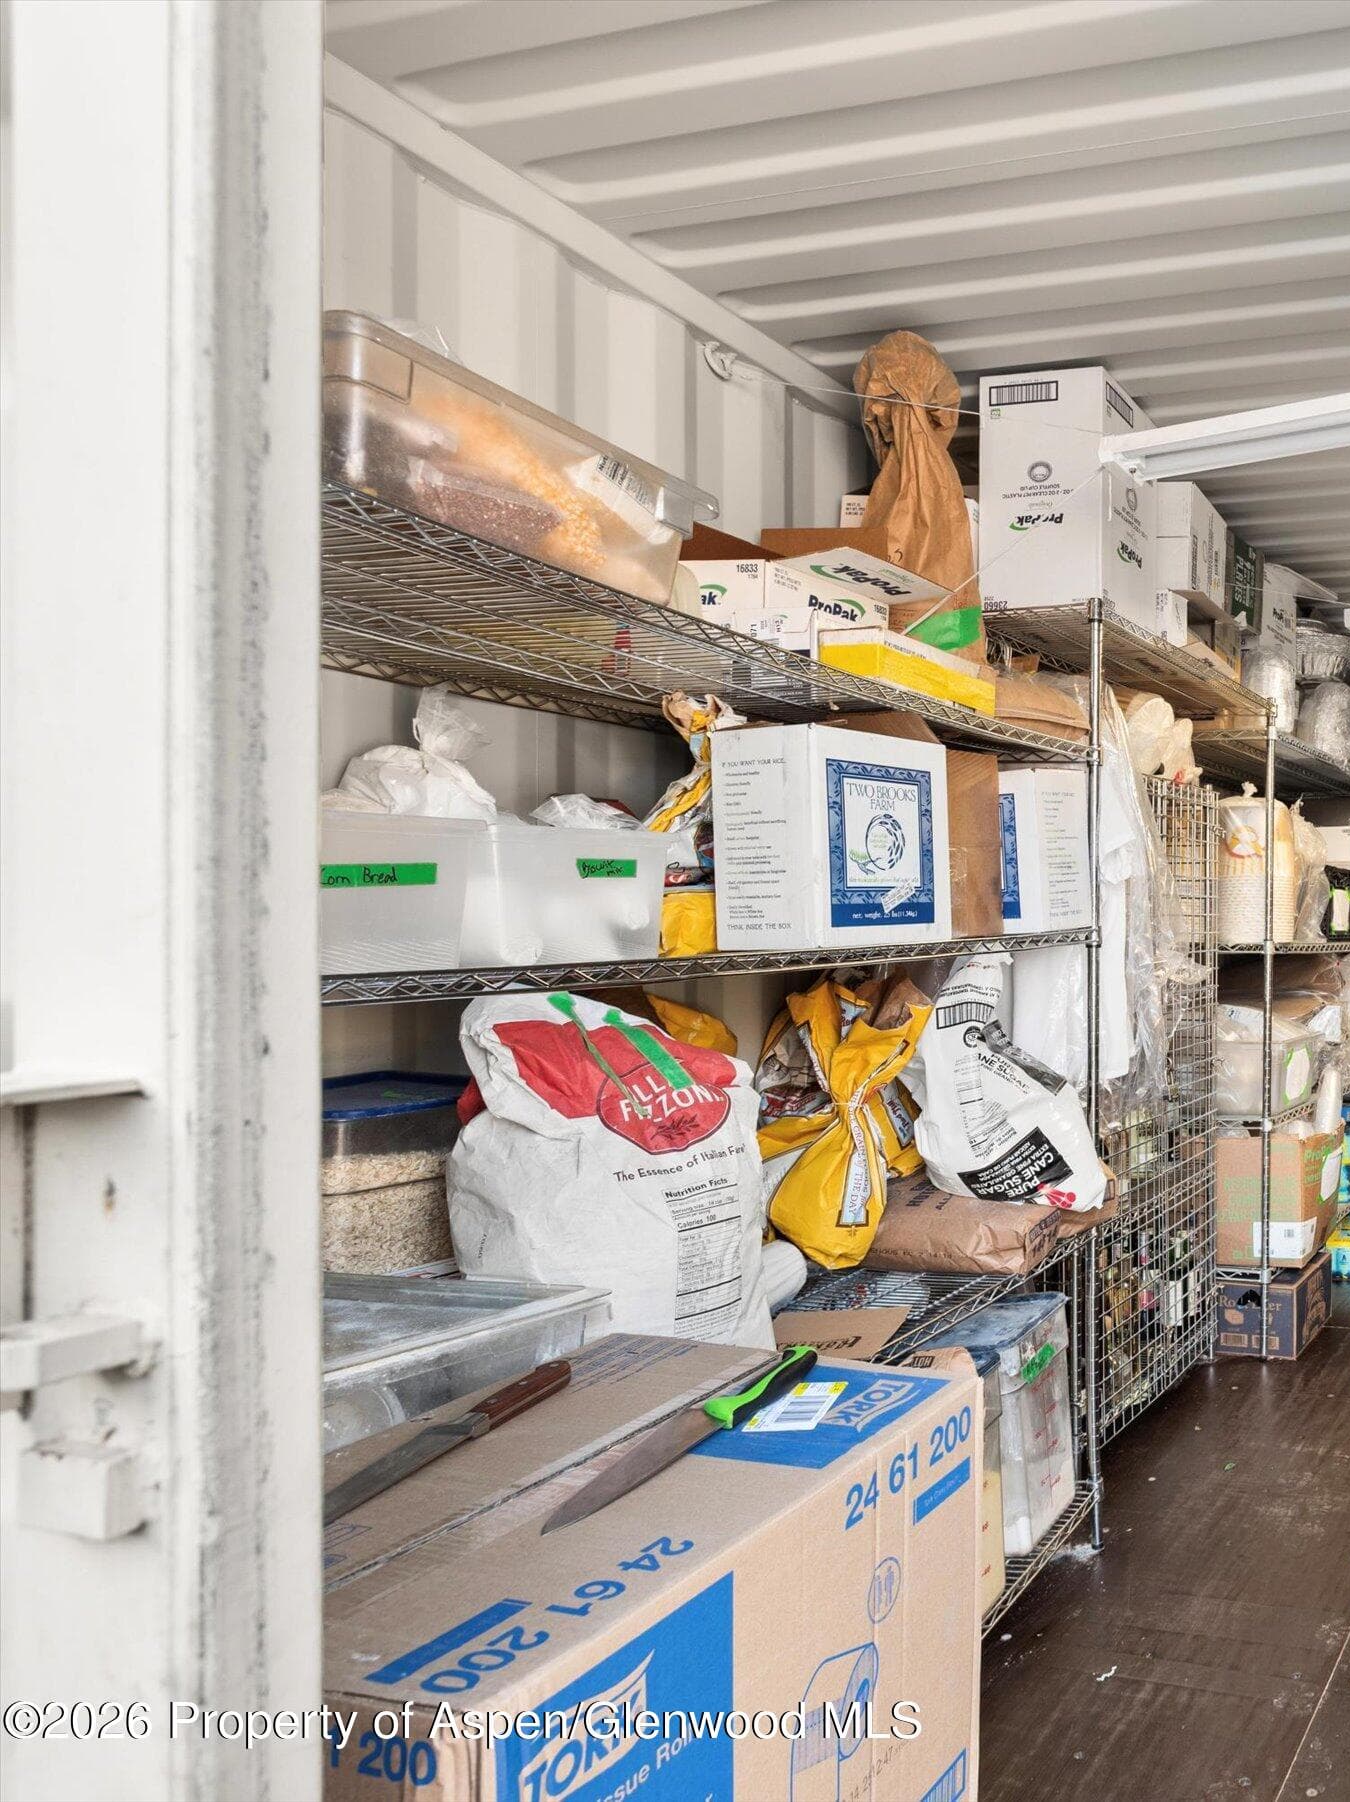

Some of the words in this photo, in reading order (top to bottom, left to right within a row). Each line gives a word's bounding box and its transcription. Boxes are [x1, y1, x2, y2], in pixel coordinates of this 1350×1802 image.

[831, 565, 912, 596] ProPak
[846, 782, 875, 799] TWO
[876, 785, 917, 802] BROOKS
[870, 798, 895, 811] FARM
[362, 865, 398, 884] Bread
[1031, 1143, 1050, 1160] EXTRA
[613, 1169, 635, 1183] The
[637, 1165, 683, 1179] Essence
[686, 1154, 700, 1169] of
[700, 1149, 728, 1162] Italian
[1015, 1158, 1032, 1173] FINE
[1021, 1151, 1054, 1178] CANE
[665, 1181, 707, 1199] Nutrition
[709, 1177, 728, 1188] Facts
[975, 1175, 1023, 1196] SUGAR
[1006, 1178, 1041, 1199] PURE
[677, 1217, 704, 1230] Calories
[836, 1382, 908, 1425] TORK
[845, 1470, 881, 1531] 24
[888, 1441, 919, 1496] 61
[929, 1404, 972, 1468] 200
[616, 1536, 694, 1571] 24
[544, 1579, 627, 1617] 61
[419, 1625, 550, 1694] 200
[359, 1731, 437, 1787] 200
